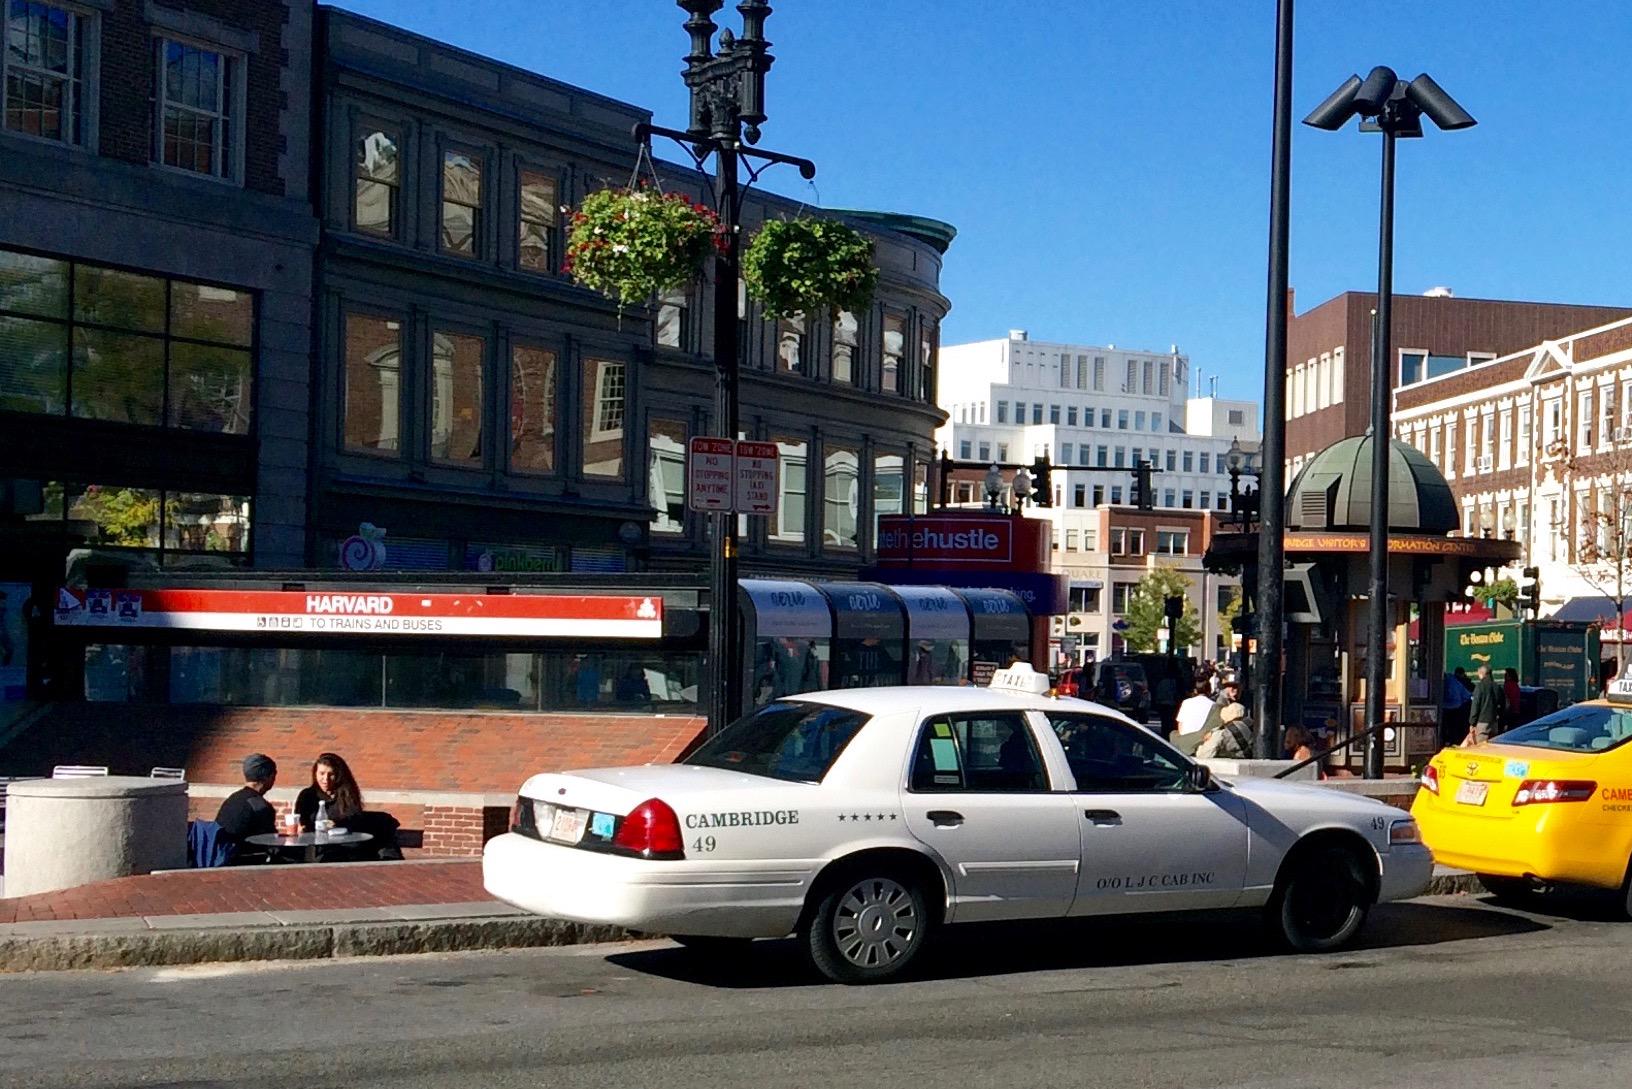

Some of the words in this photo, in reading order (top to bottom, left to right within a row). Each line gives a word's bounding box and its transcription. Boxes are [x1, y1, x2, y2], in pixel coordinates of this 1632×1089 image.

[705, 456, 718, 465] NO
[740, 469, 774, 480] STOPPING
[695, 483, 728, 494] ANYTIME
[746, 490, 768, 500] STAND
[1387, 538, 1440, 551] ORMATION
[306, 595, 393, 613] HARVARD
[849, 592, 881, 611] aerie
[310, 617, 326, 628] TO
[329, 618, 372, 629] TRAINS
[374, 618, 400, 629] AND
[402, 619, 442, 630] BUSES
[1460, 635, 1470, 645] The
[1471, 634, 1488, 645] Boston
[1489, 632, 1504, 644] Globe
[1003, 674, 1025, 687] TAXI
[686, 810, 800, 829] CAMBRIDGE
[1370, 816, 1385, 830] 49
[692, 835, 717, 853] 49
[1096, 878, 1121, 889] O/O
[1125, 876, 1133, 888] L
[1137, 876, 1145, 887] J
[1149, 875, 1159, 887] C
[1161, 874, 1188, 886] CAB
[1191, 872, 1215, 885] INC
